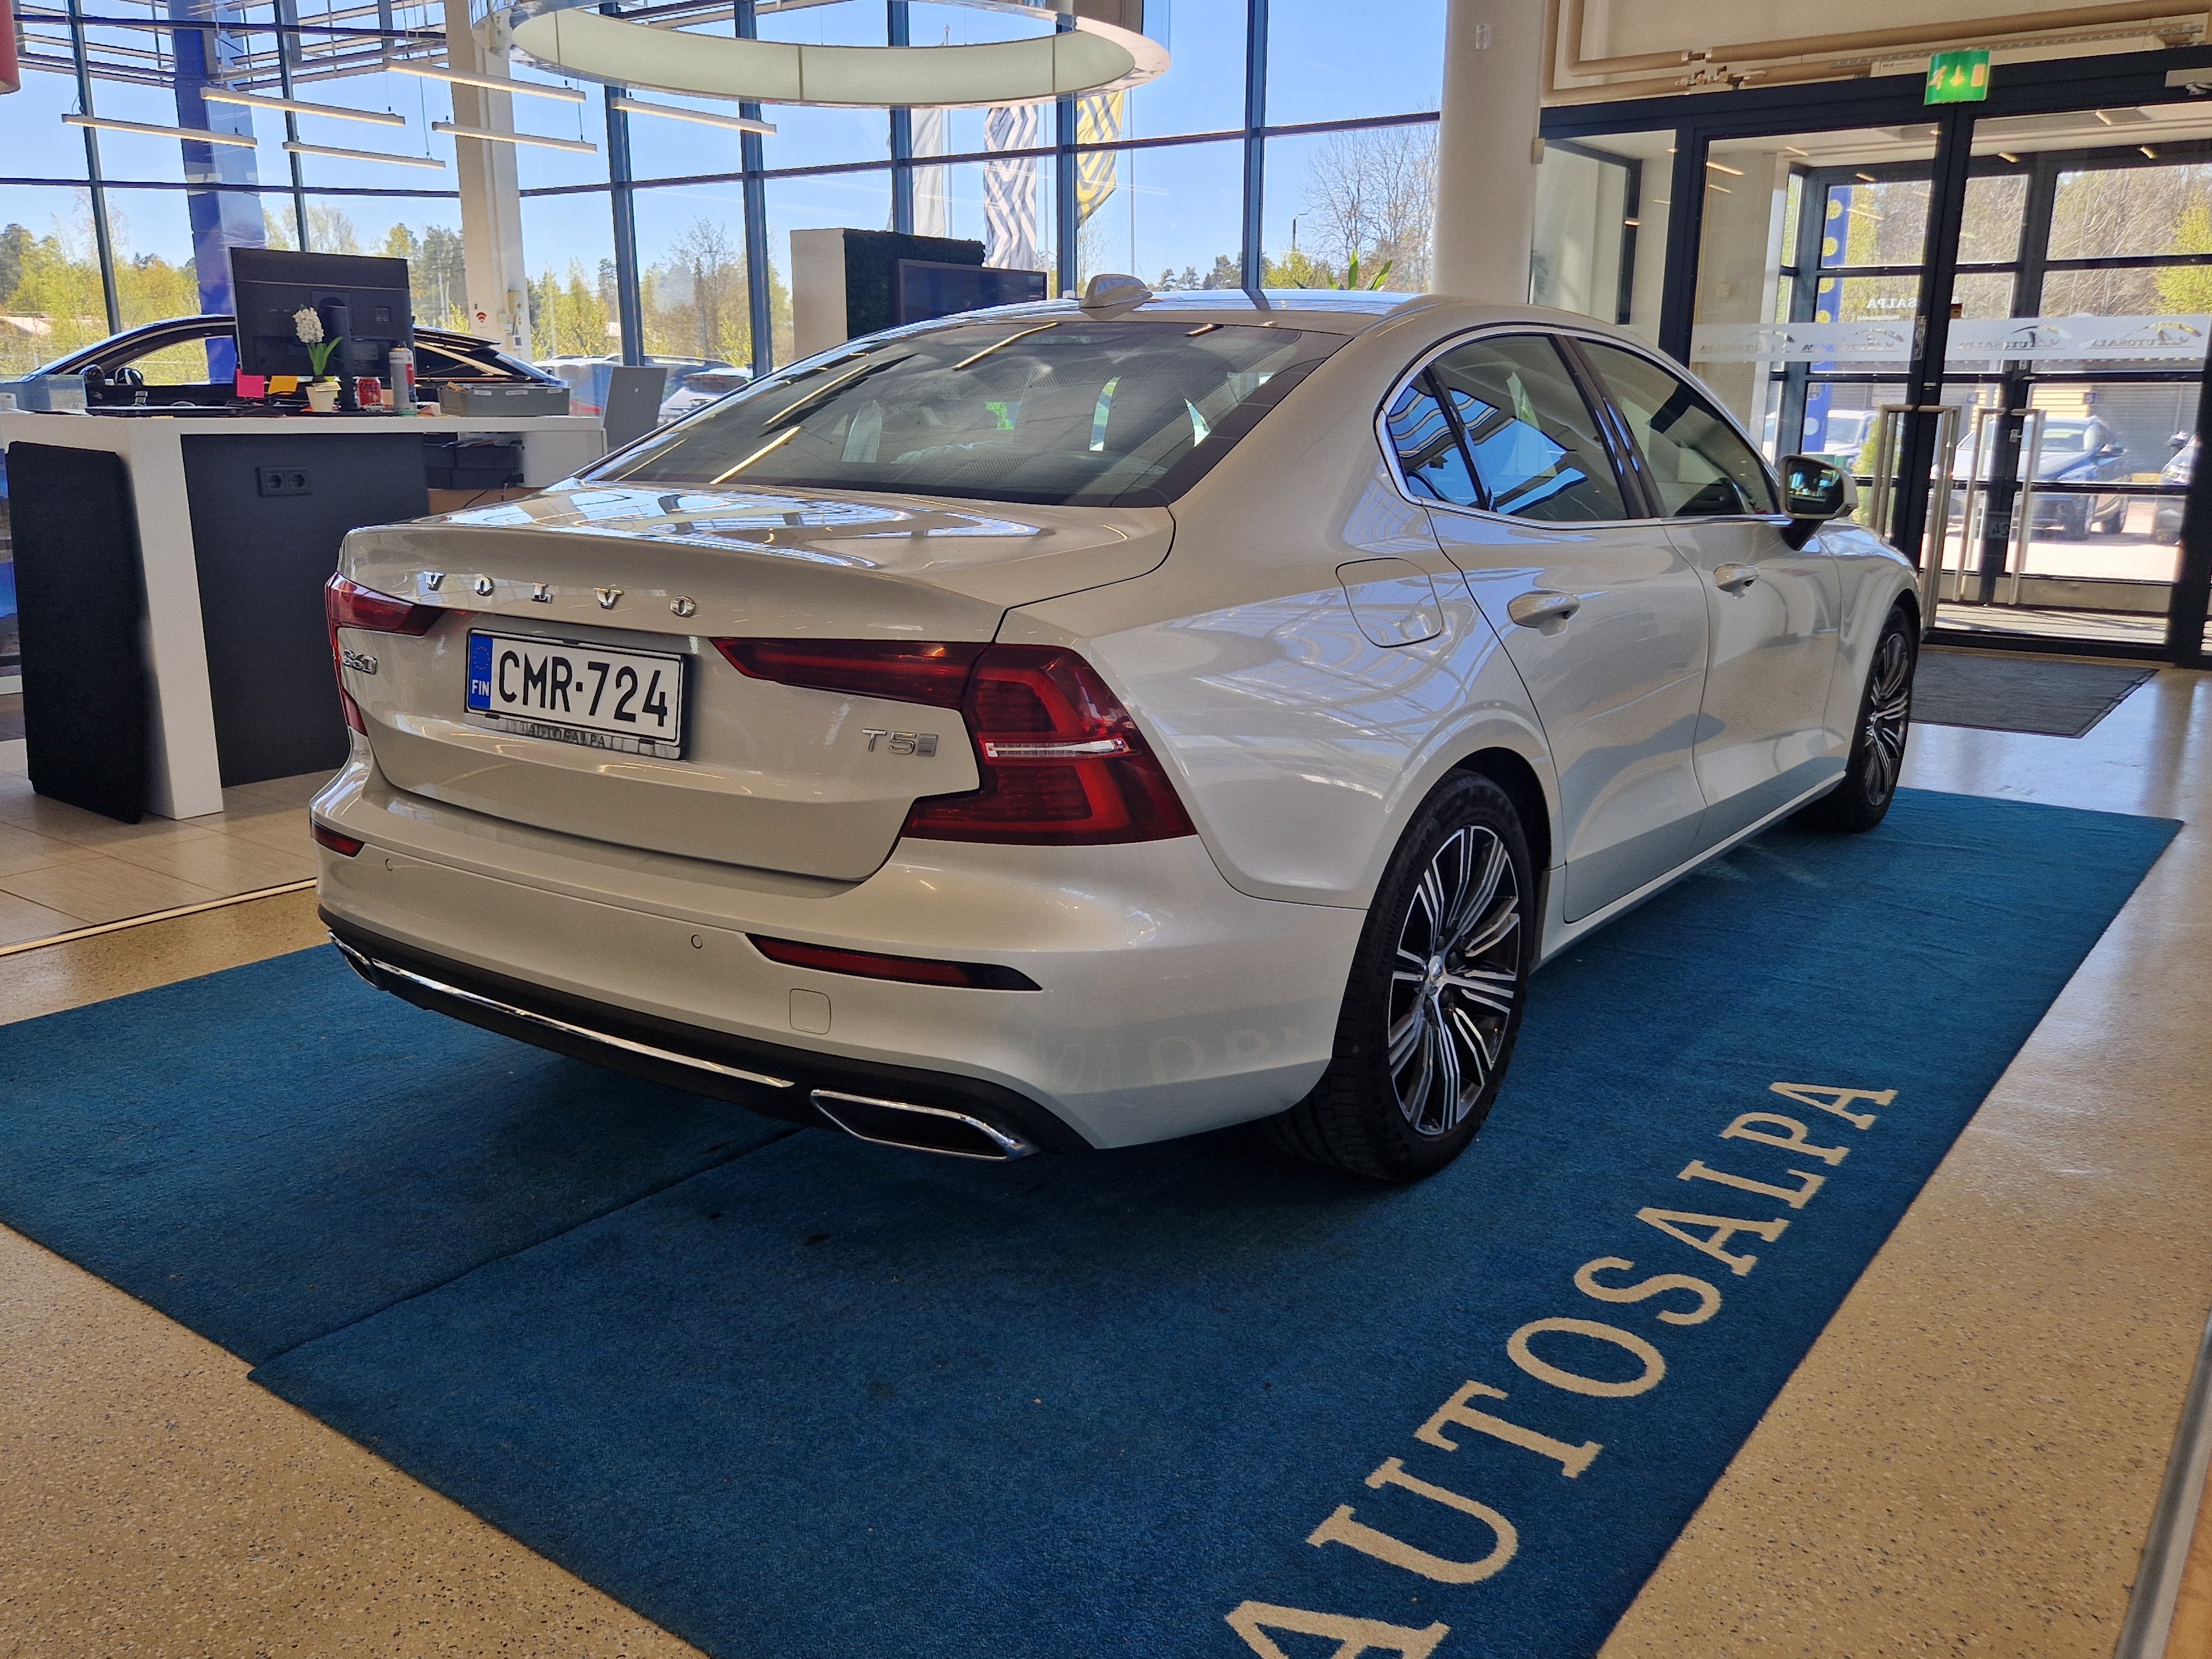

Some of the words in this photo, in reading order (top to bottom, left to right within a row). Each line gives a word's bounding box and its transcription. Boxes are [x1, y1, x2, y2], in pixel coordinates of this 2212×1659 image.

[423, 571, 696, 618] VOLVO
[471, 680, 489, 696] FIN
[862, 728, 916, 754] T5
[1225, 1082, 1897, 1659] AUTOSALPA
